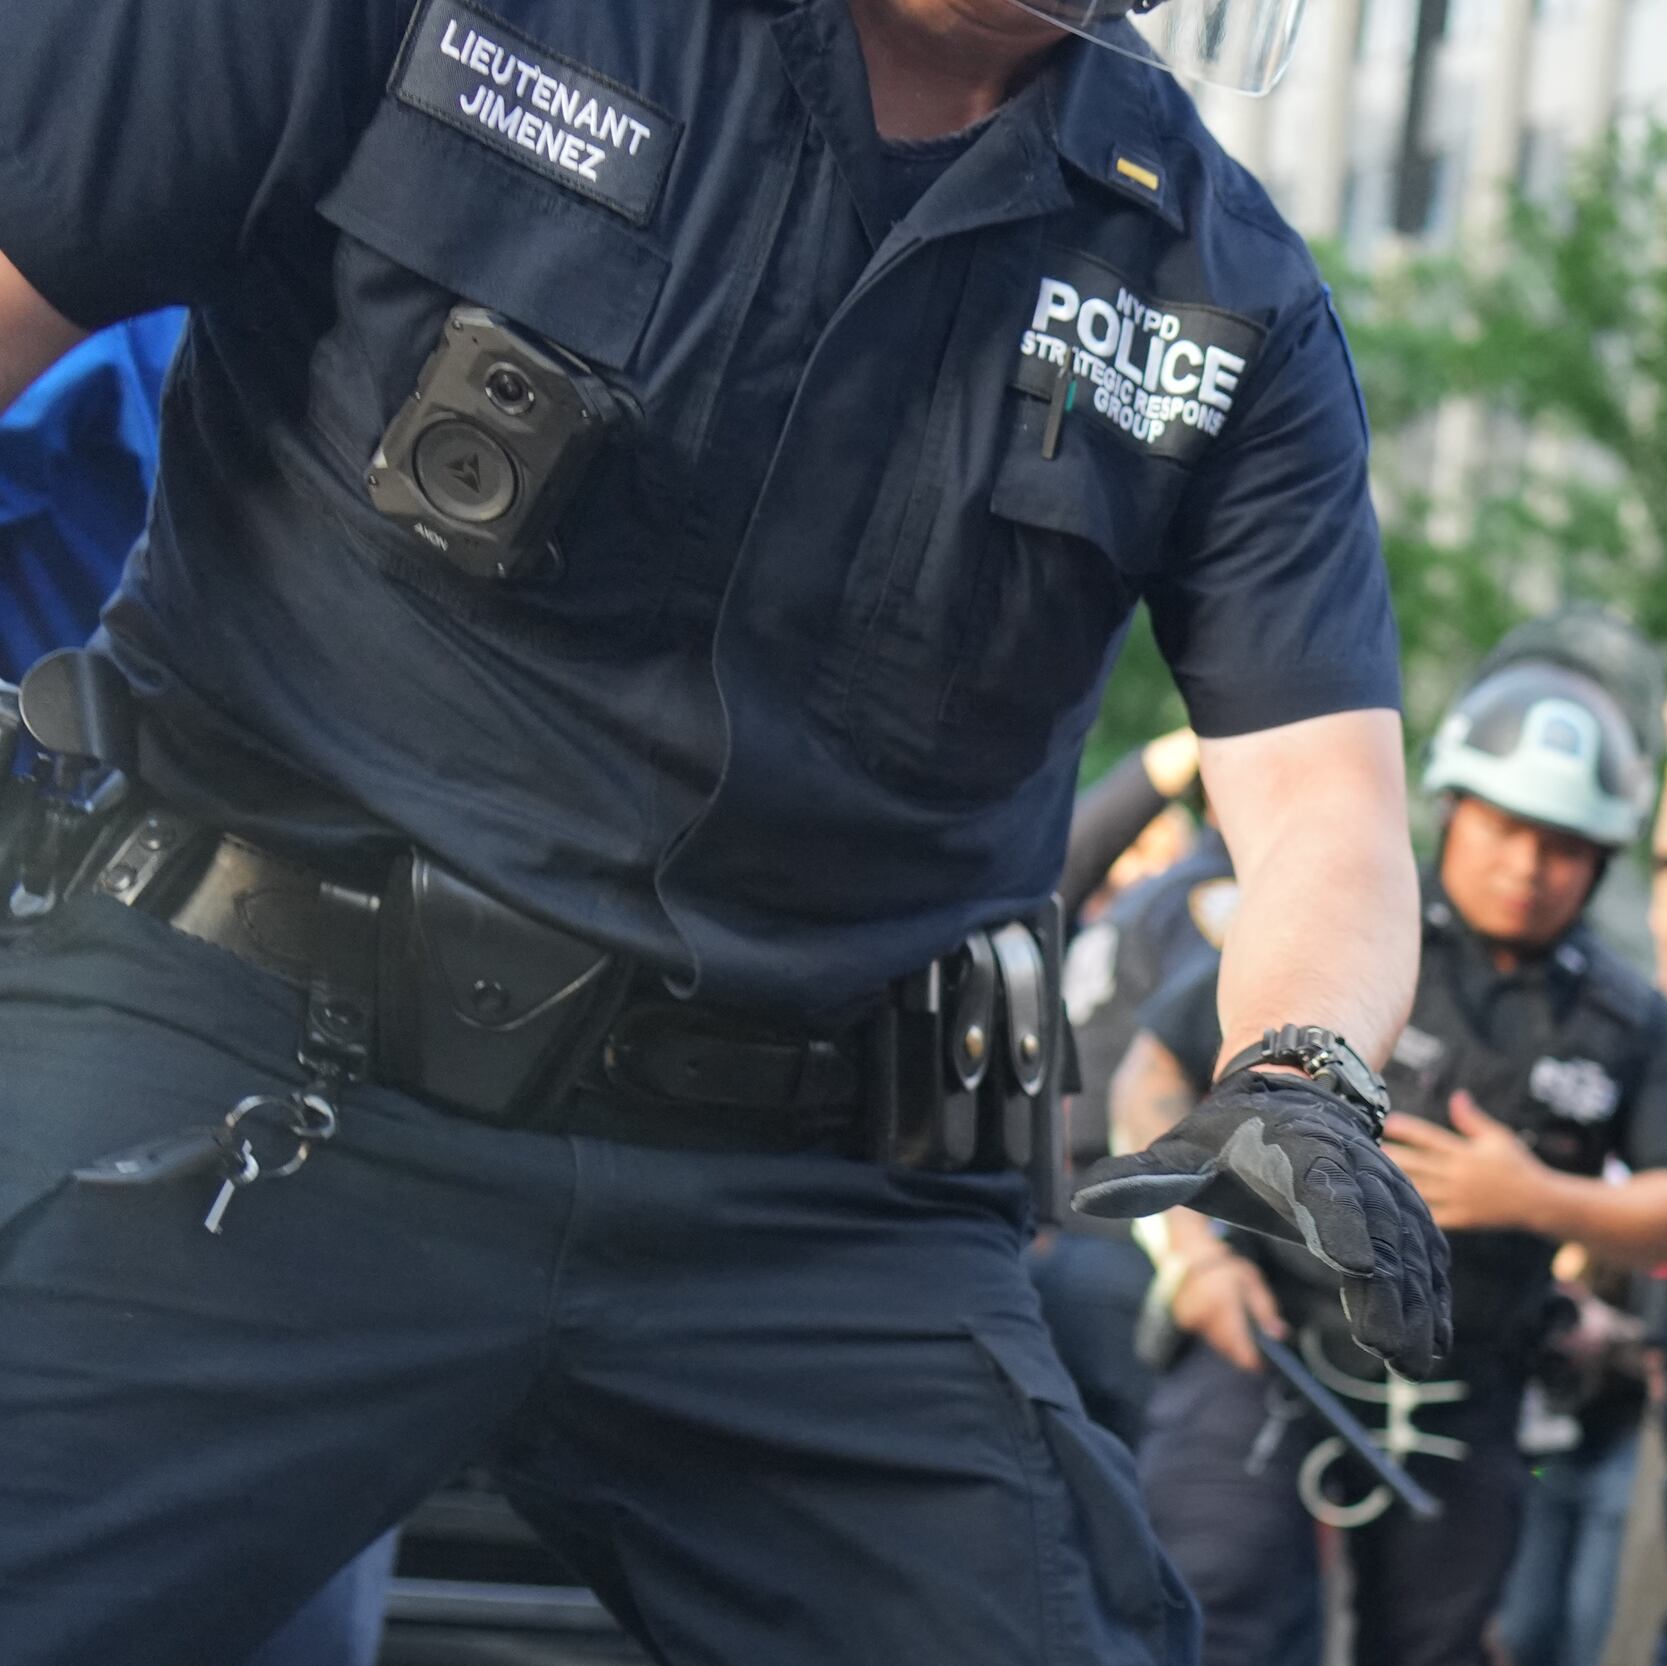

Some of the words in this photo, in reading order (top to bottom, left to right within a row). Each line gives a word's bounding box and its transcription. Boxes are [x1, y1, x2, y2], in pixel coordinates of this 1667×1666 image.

[440, 18, 651, 156] LIEUTENANT
[459, 84, 606, 182] JIMENEZ
[1031, 277, 1246, 412] POLICE
[1116, 286, 1180, 341] NYPD
[1093, 387, 1167, 444] GROUP
[1133, 386, 1227, 438] RESPONS
